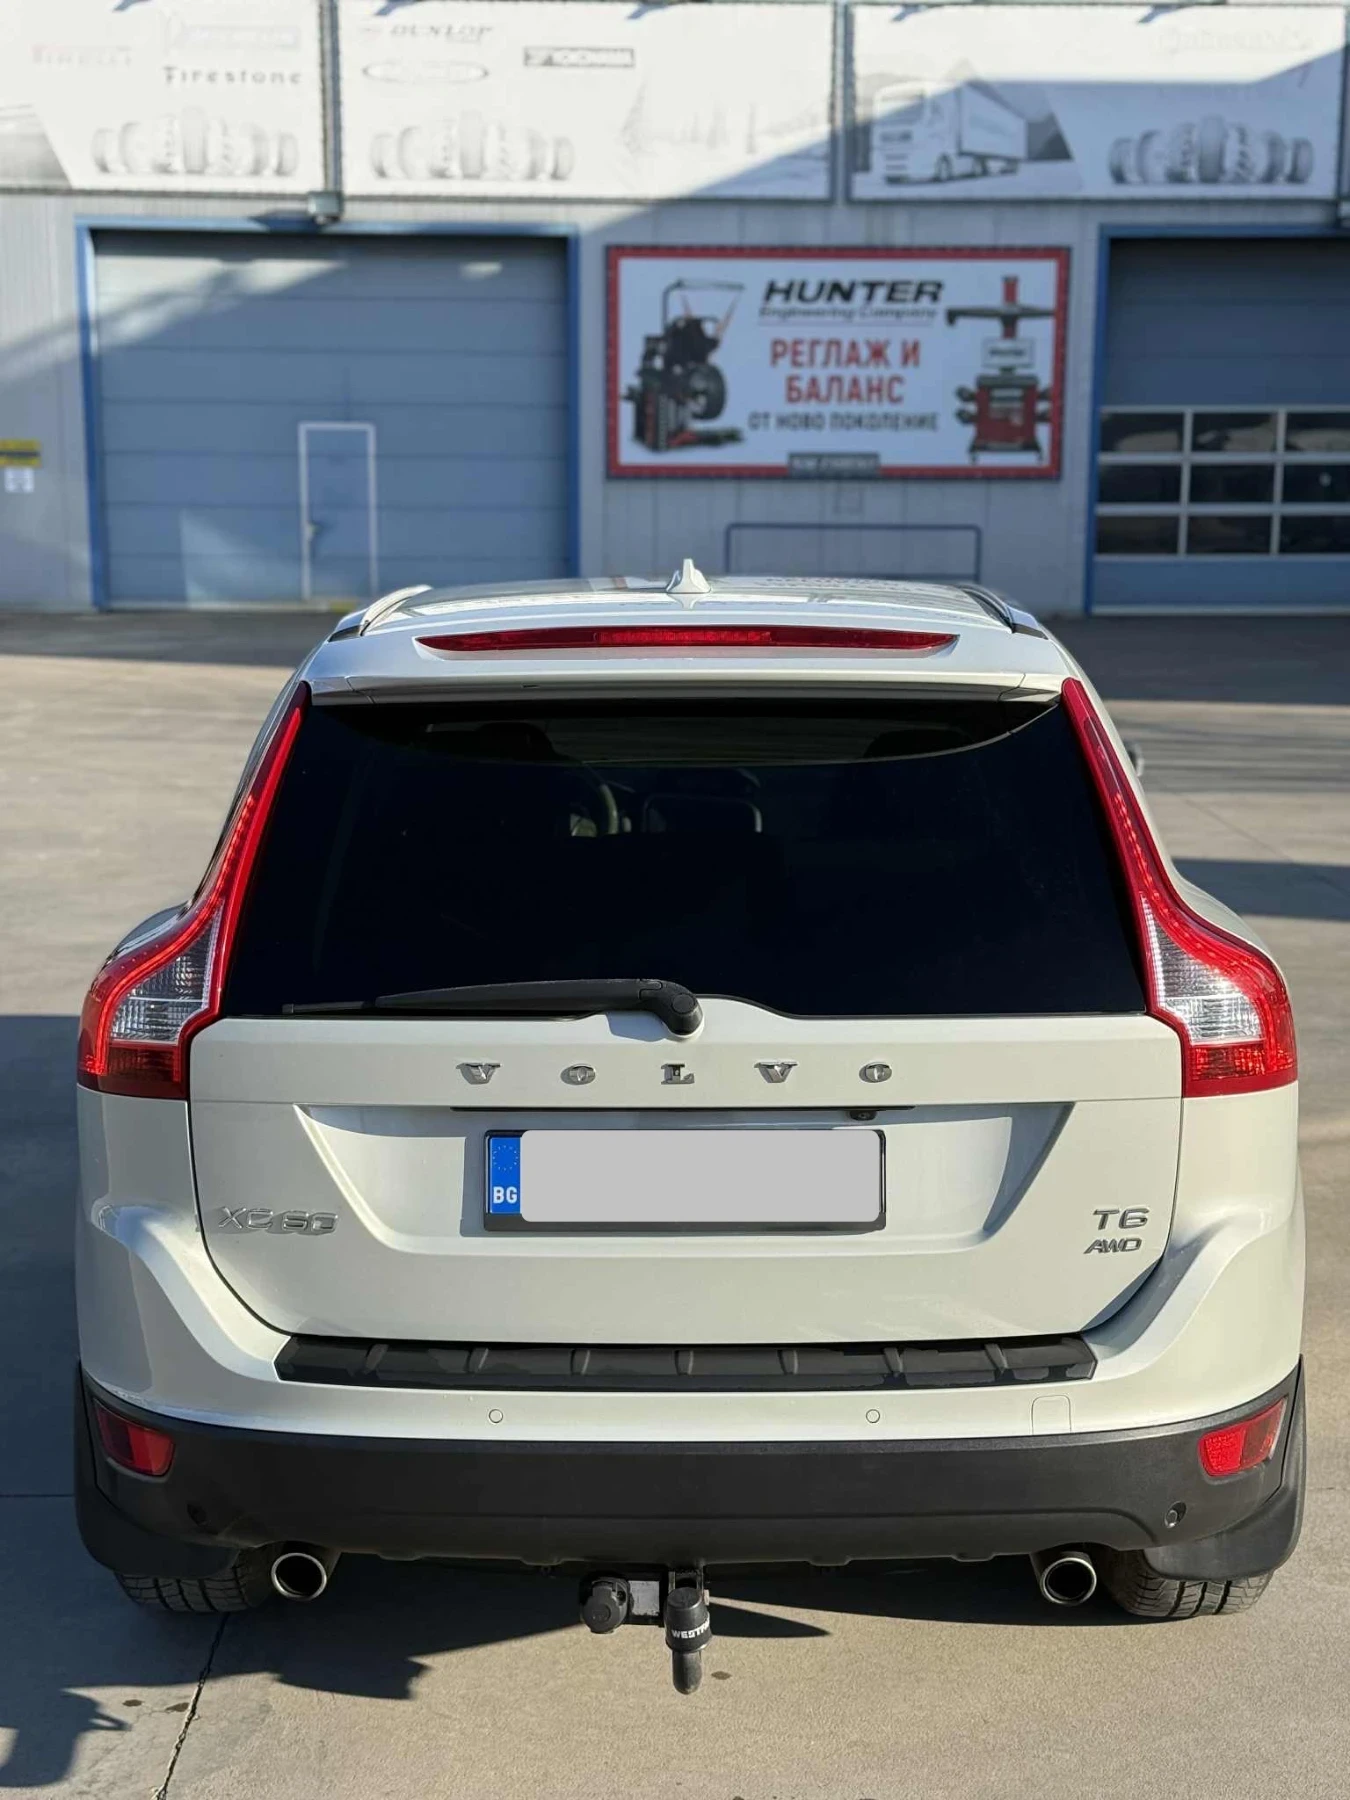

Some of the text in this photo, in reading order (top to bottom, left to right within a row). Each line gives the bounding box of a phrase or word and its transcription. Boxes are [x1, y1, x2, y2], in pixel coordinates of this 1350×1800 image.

[764, 279, 943, 303] HUNTER
[760, 305, 855, 322] Engineering
[770, 339, 920, 368] РЕГЛАЖ И
[786, 374, 904, 403] БАЛАНС
[749, 411, 770, 430] ОТ
[776, 411, 825, 430] НОВО
[456, 1062, 893, 1085] VOLVO
[492, 1186, 518, 1204] BG
[219, 1206, 338, 1233] XC60
[1093, 1208, 1149, 1230] T6
[1083, 1238, 1142, 1254] AWD
